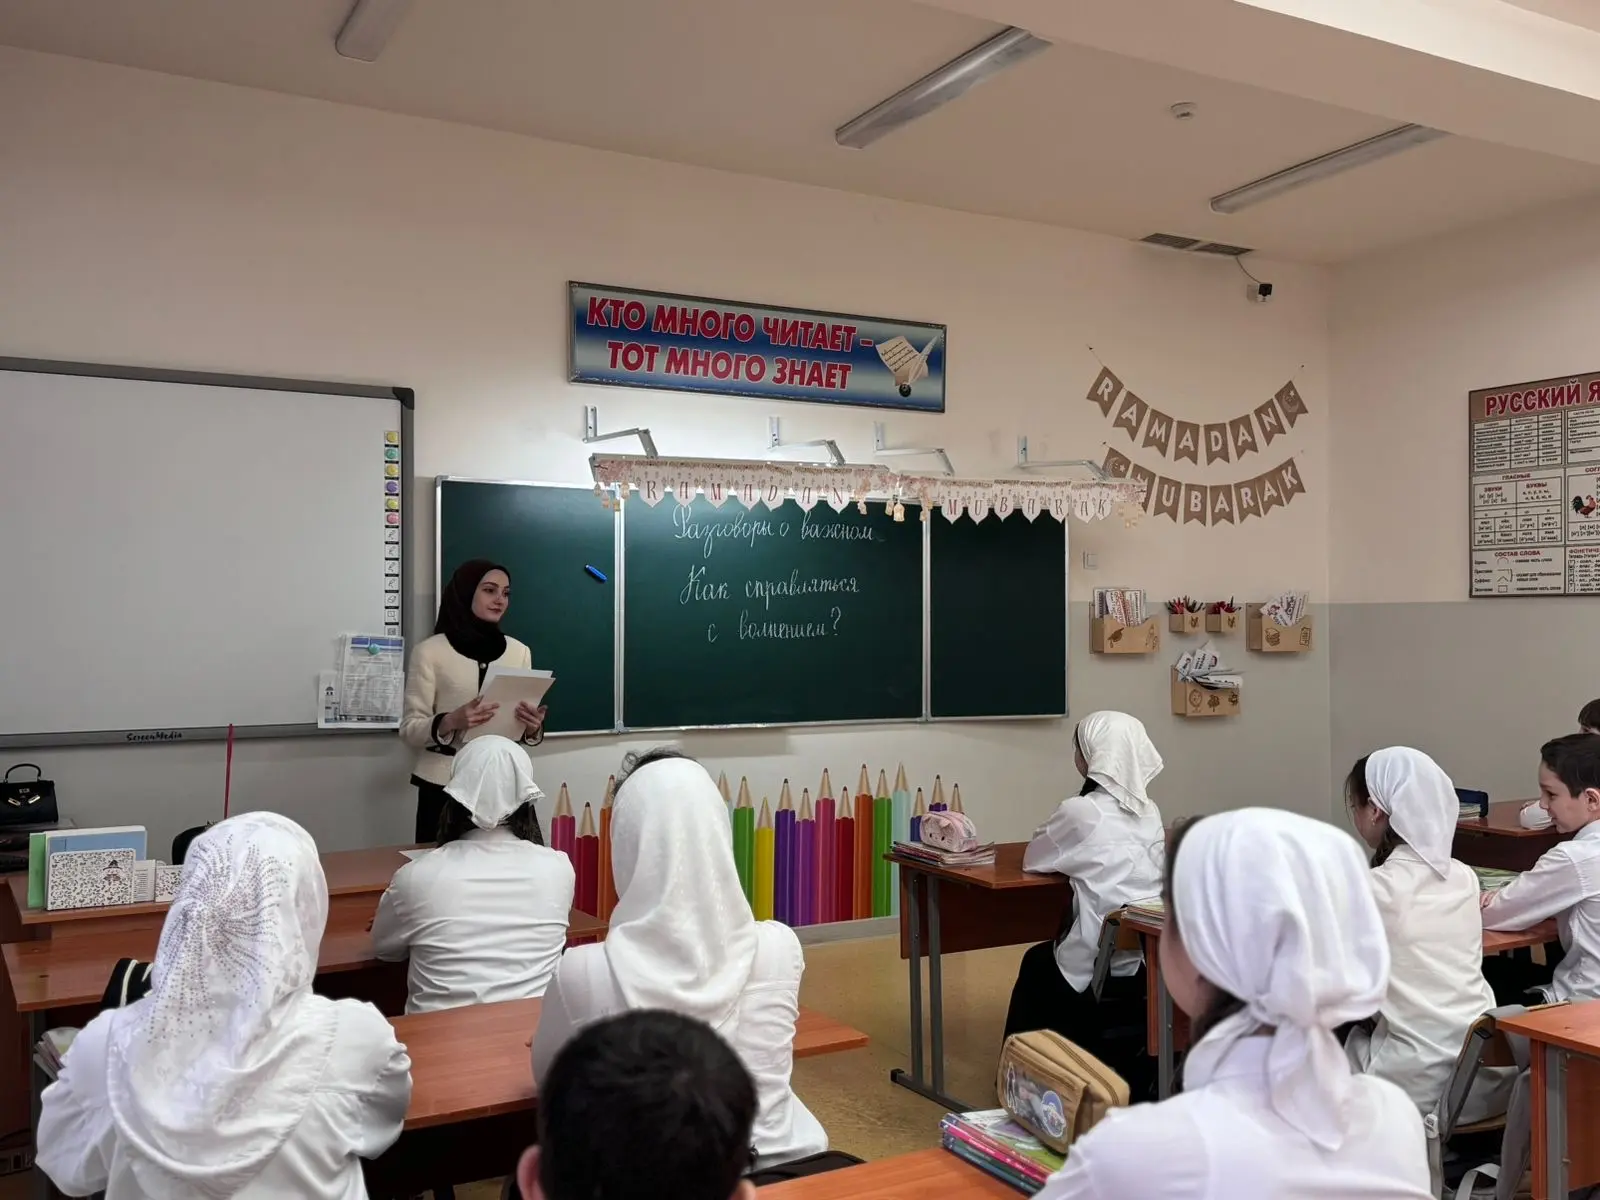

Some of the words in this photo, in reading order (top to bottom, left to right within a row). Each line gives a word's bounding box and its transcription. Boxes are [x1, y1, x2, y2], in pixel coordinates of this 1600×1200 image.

[587, 296, 646, 330] КТО
[652, 304, 755, 342] МНОГО
[761, 317, 856, 352] ЧИТАЕТ
[607, 340, 660, 373] ТОТ
[664, 346, 766, 383] МНОГО
[772, 355, 852, 390] ЗНАЕТ
[1097, 376, 1278, 452] RAMADAN
[1485, 378, 1581, 416] РУССКИЙ
[646, 480, 844, 505] RAMADAN
[947, 496, 1106, 517] MUBARAK
[1137, 465, 1298, 513] UBARAK
[673, 504, 775, 559] Разговоры
[779, 521, 790, 537] о
[801, 511, 874, 541] важном
[680, 564, 732, 605] Как
[745, 568, 860, 610] справляться
[707, 623, 719, 643] с
[738, 606, 841, 640] волнением?
[126, 731, 183, 741] ScreenMedia
